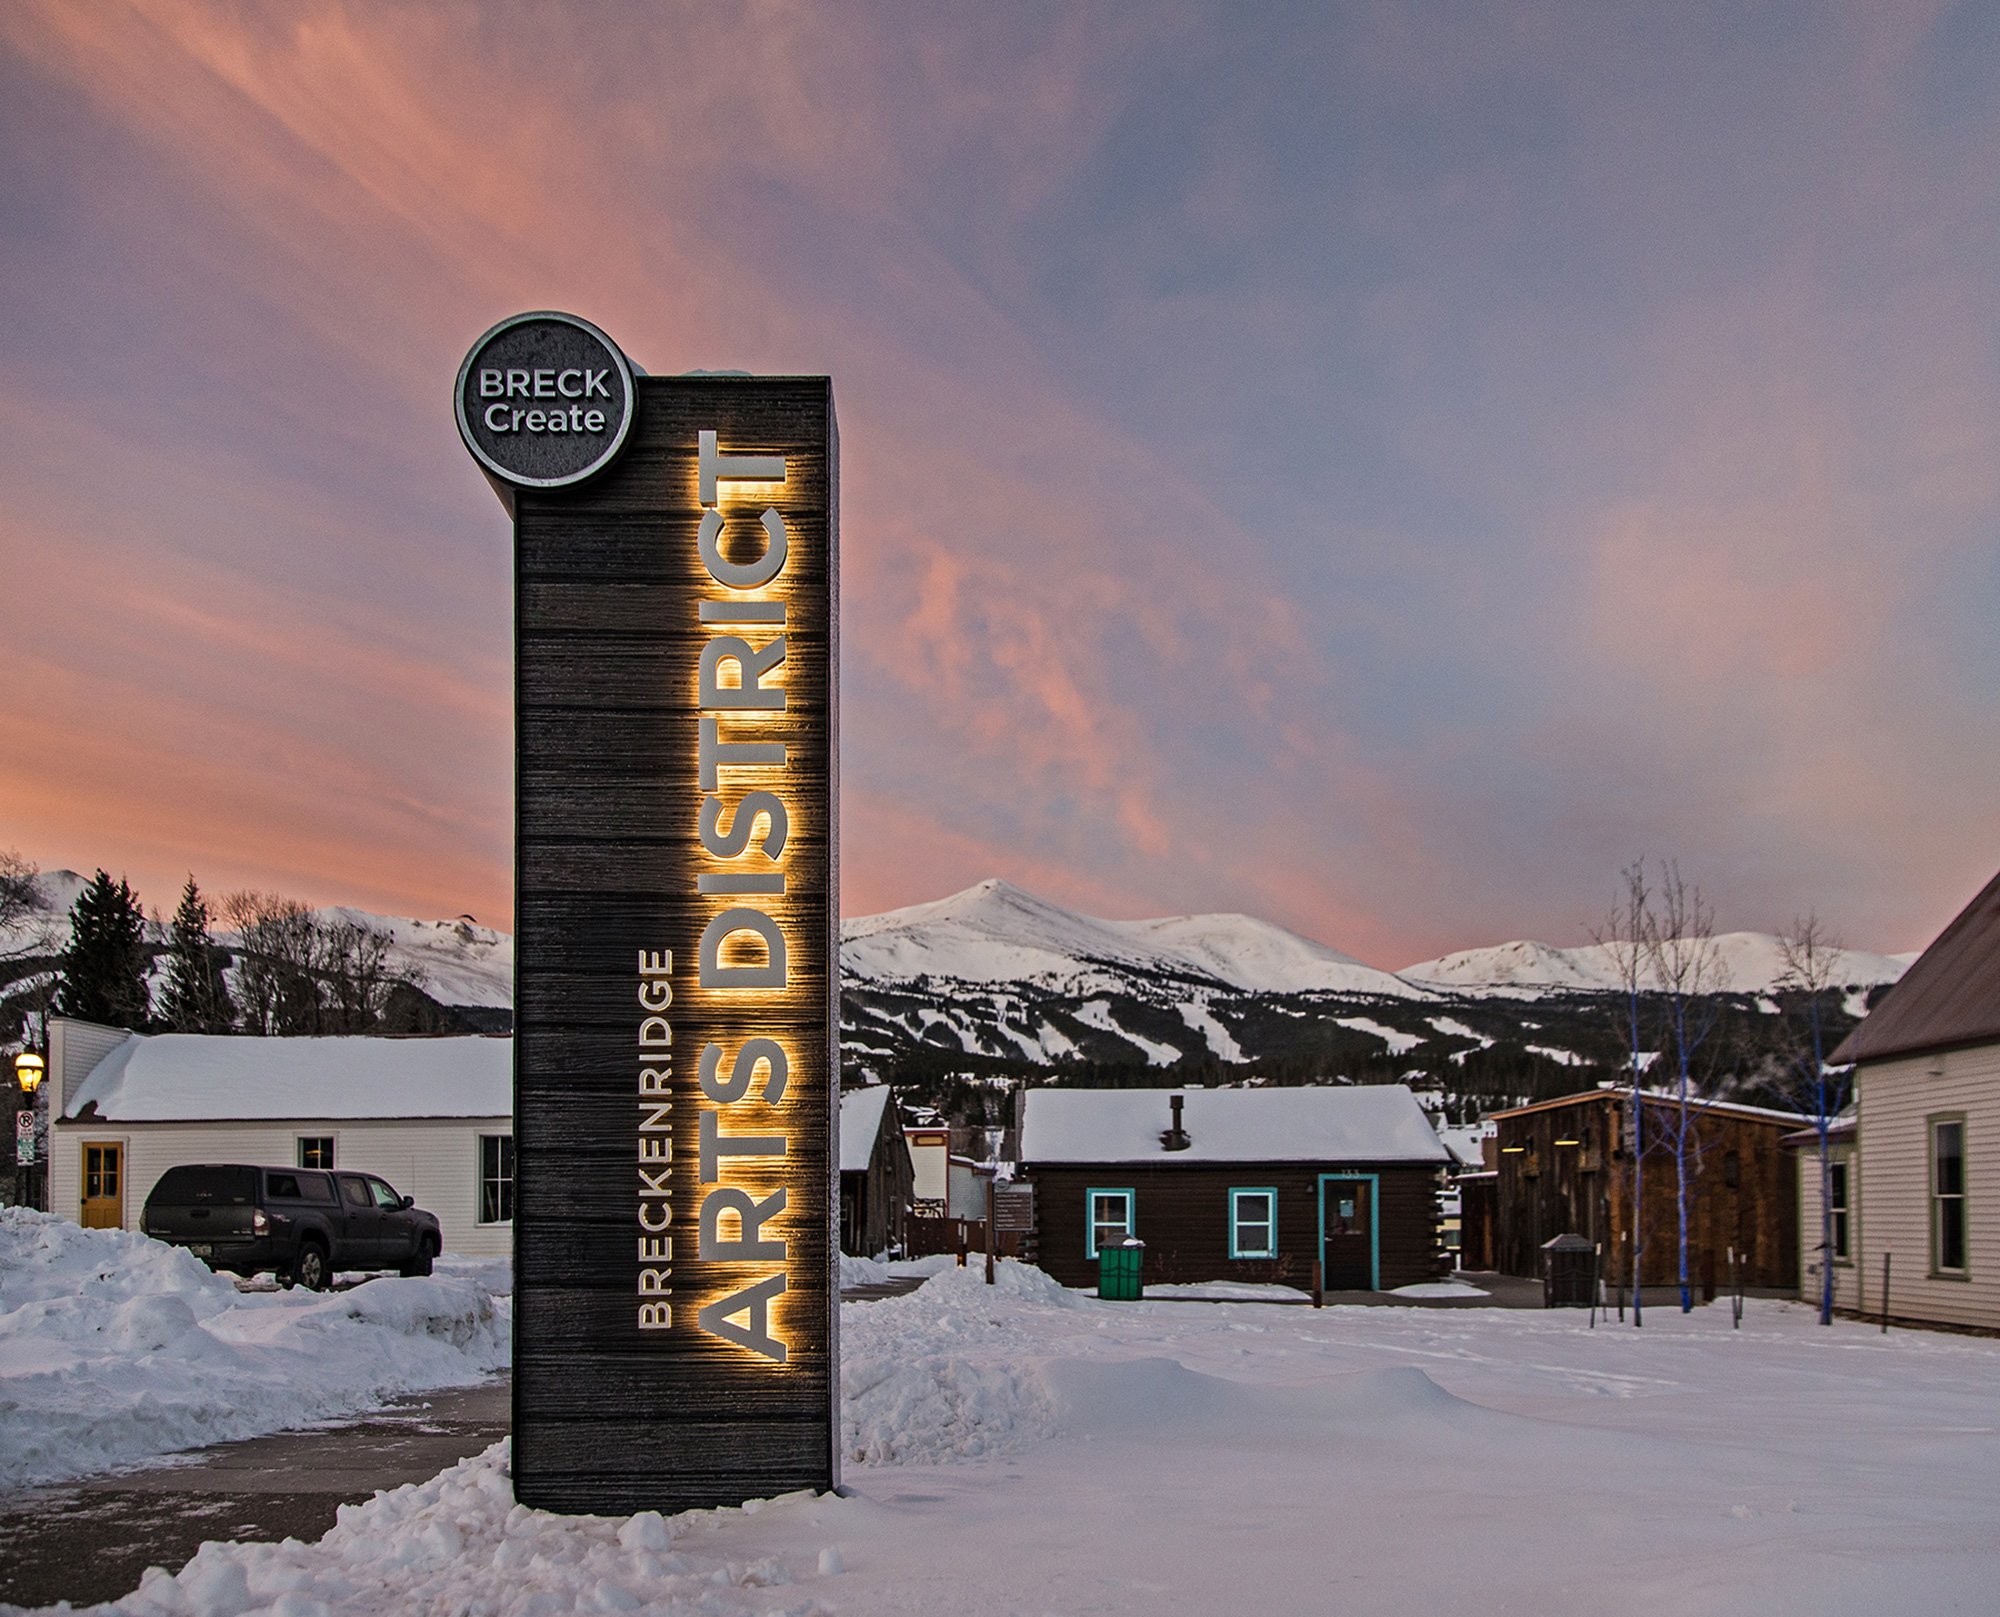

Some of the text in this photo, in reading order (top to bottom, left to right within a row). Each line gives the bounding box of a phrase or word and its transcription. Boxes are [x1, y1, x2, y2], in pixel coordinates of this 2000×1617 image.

[479, 368, 611, 398] BRECK
[484, 403, 606, 432] Create
[698, 430, 788, 1364] ARTS DISTRICT
[638, 948, 672, 1329] BRECKENRIDGE
